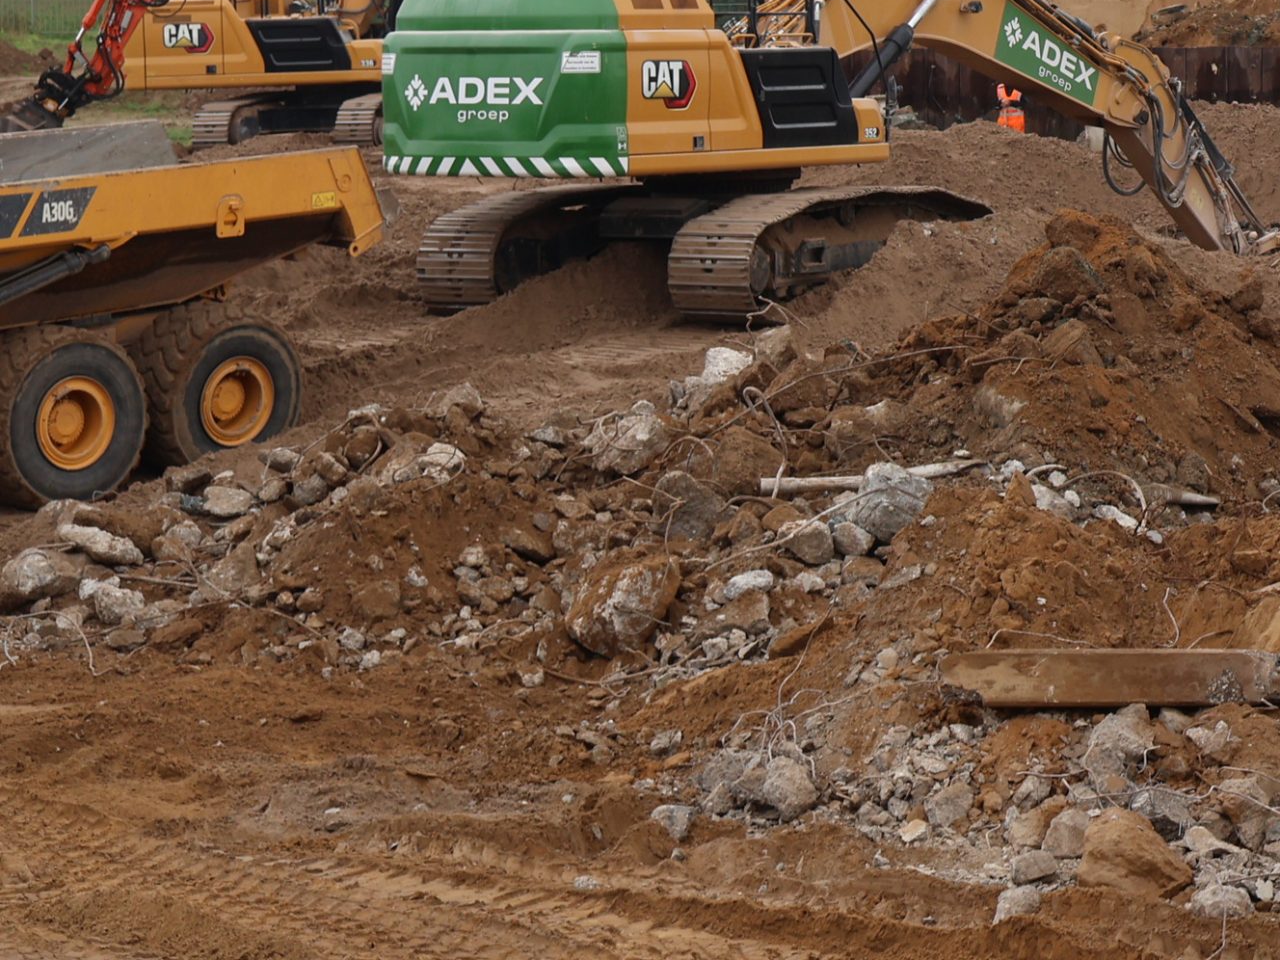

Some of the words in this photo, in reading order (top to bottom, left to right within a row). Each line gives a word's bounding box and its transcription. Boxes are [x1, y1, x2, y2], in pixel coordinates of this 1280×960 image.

[163, 23, 202, 48] CAT
[1023, 30, 1096, 91] ADEX
[428, 76, 544, 105] ADEX
[642, 60, 683, 98] CAT
[1038, 65, 1072, 91] groep
[457, 109, 509, 123] groep
[864, 127, 877, 138] 352
[41, 200, 74, 224] A30G
